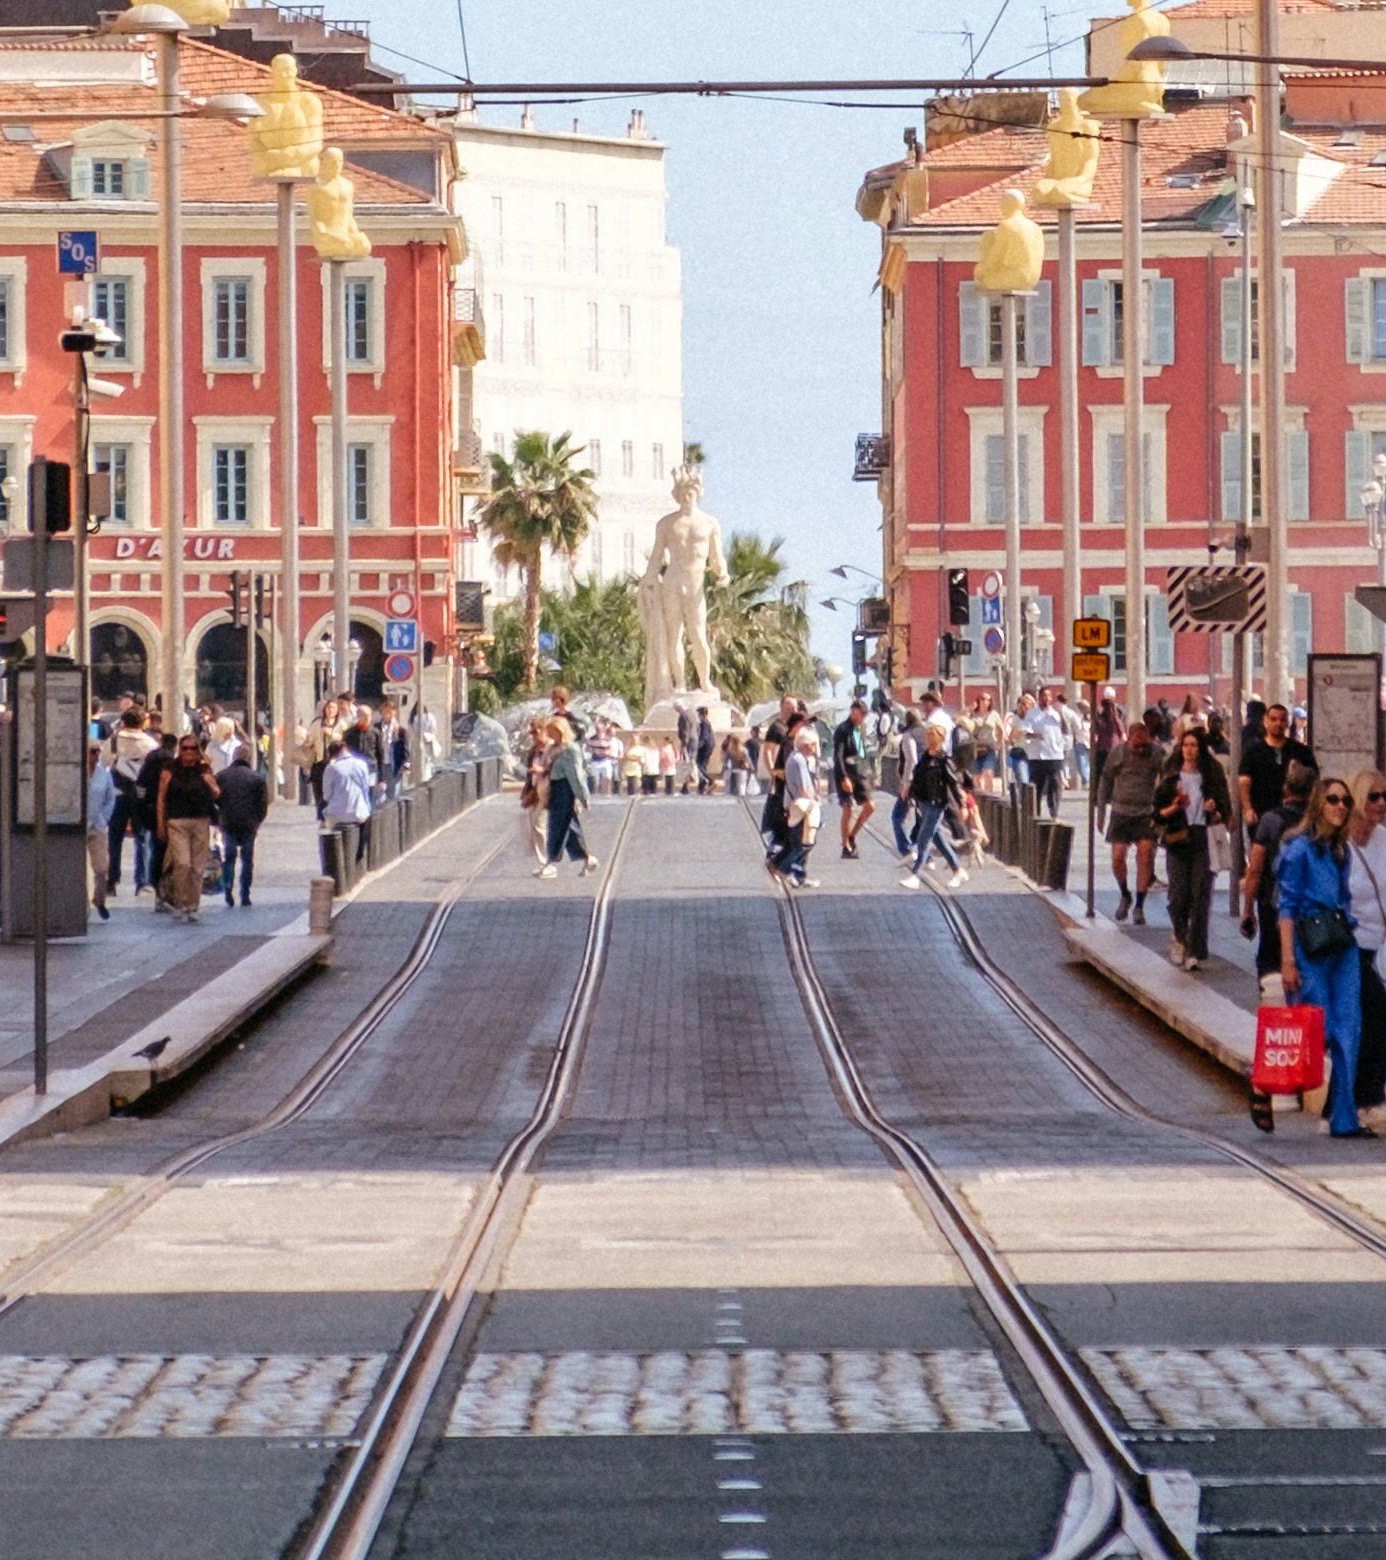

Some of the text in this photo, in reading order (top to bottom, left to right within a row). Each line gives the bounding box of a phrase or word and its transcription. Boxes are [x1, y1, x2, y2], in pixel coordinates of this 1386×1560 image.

[61, 232, 95, 272] SOS
[1082, 628, 1101, 640] LM
[1265, 1028, 1303, 1045] MINI
